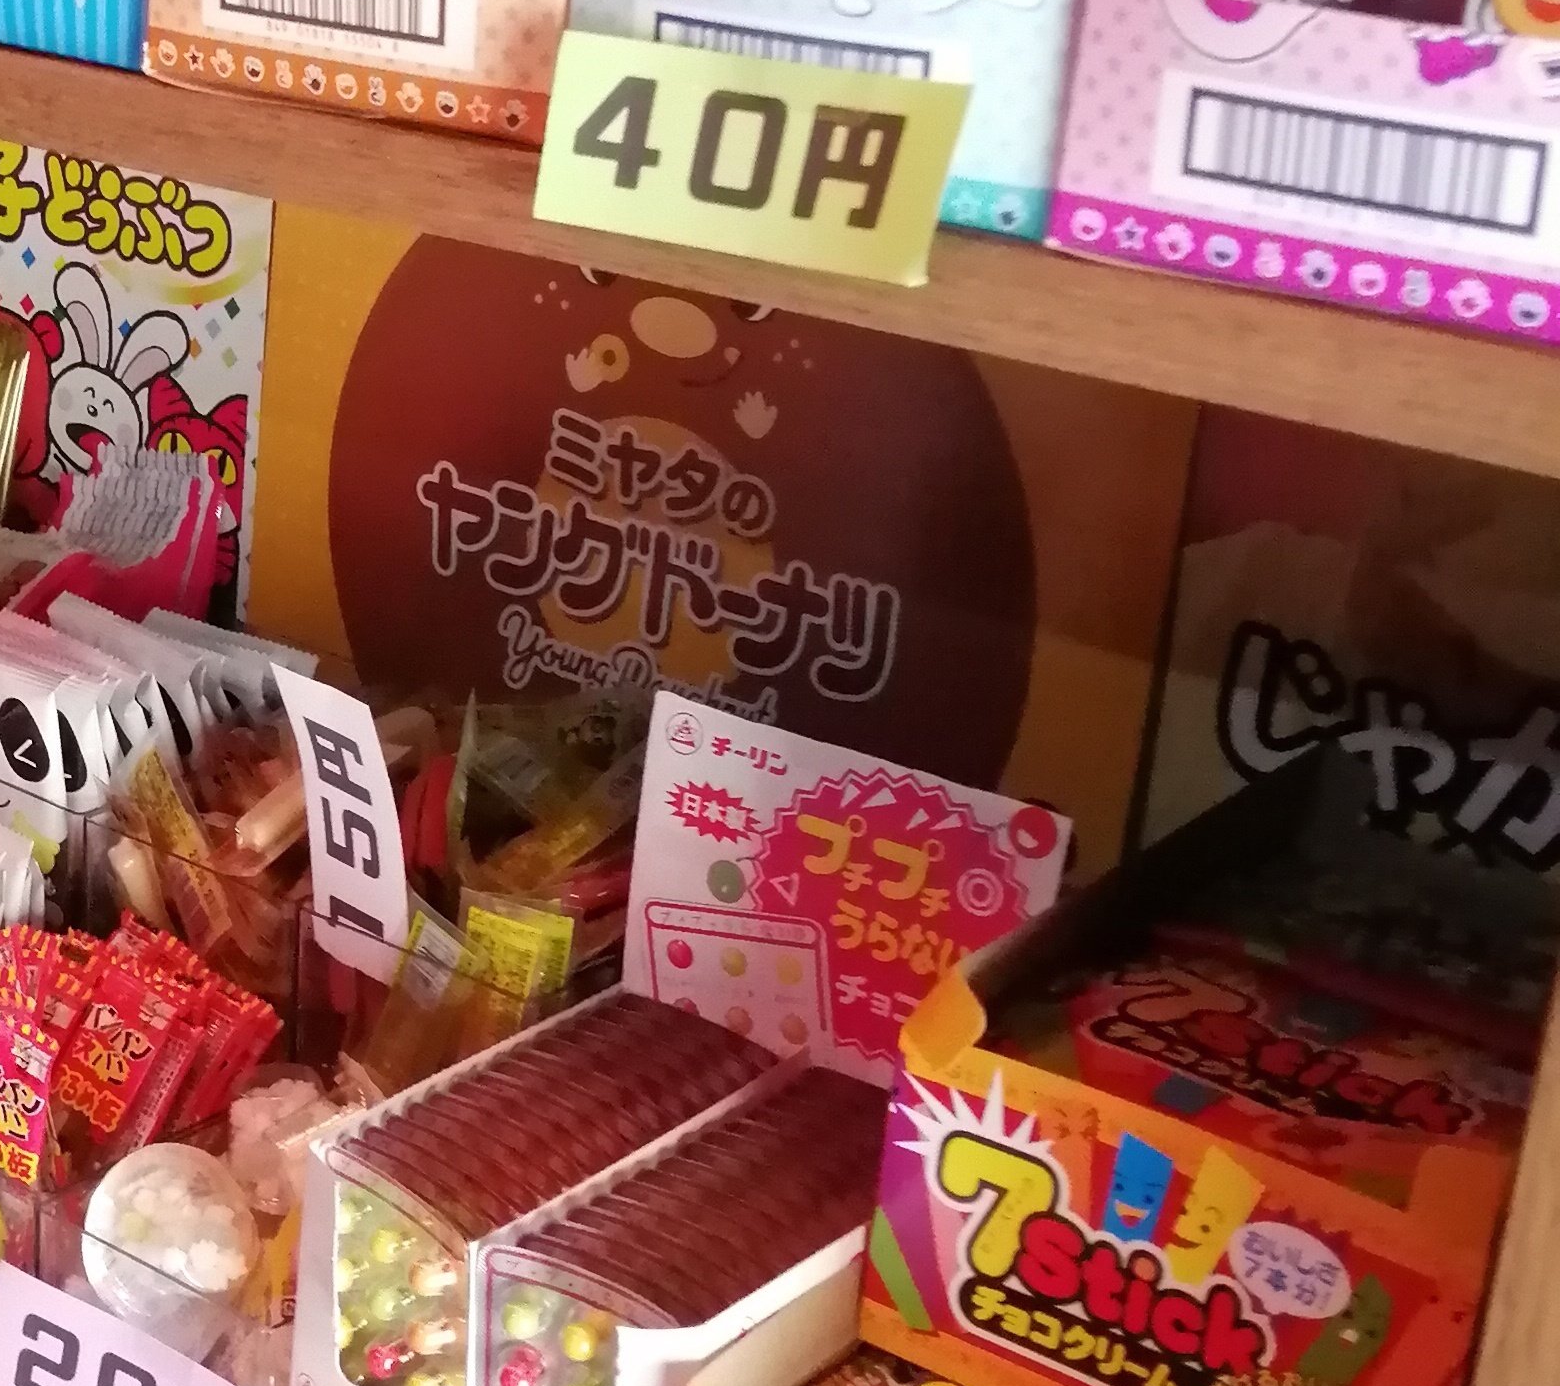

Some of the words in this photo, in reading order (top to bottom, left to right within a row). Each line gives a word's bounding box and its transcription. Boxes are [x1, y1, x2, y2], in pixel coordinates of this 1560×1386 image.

[574, 76, 908, 231] 40円
[546, 409, 776, 537] ミヤタの
[417, 462, 900, 702] ヤングドーナツ
[498, 603, 615, 689] Young
[712, 737, 788, 775] チーリン
[302, 715, 385, 941] 15円
[796, 814, 952, 917] プチプチ
[941, 1132, 1057, 1276] 7
[1018, 1216, 1264, 1369] Stick
